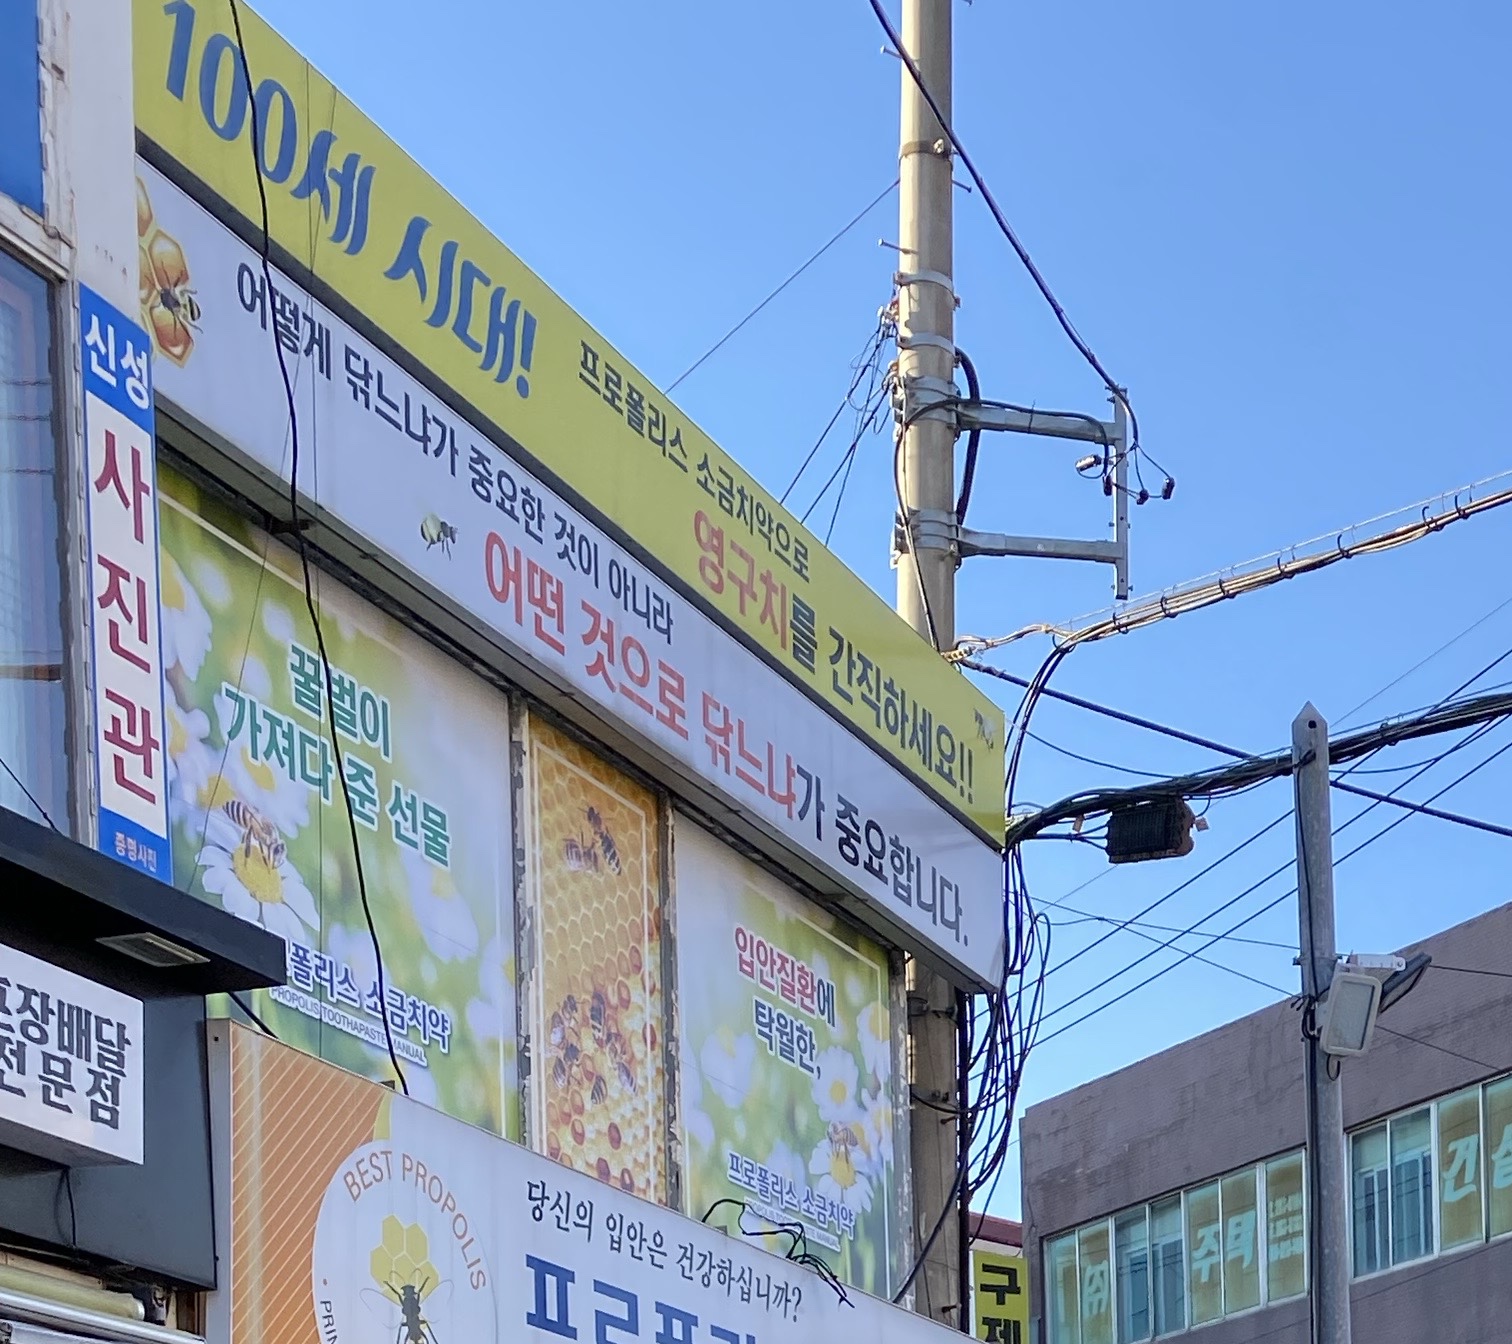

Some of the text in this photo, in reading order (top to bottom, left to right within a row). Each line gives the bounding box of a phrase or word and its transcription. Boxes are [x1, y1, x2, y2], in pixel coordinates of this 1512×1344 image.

[164, 0, 537, 399] 100세 시대!
[85, 314, 151, 410] 신성
[237, 262, 673, 644] 어떻게 닦느냐가 중요한 것이 아니라
[578, 340, 810, 583] 프로폴리스 소금치약으로
[94, 428, 160, 804] 사진관
[693, 509, 975, 804] 영구치를 간직하세요!!
[291, 644, 390, 757] 꿀벌이
[484, 529, 970, 945] 어떤 것으로 닦느냐가 중요합니다.
[223, 687, 450, 866] 가져다 준 선물
[113, 830, 158, 873] 증명사진
[271, 987, 319, 1015] PROPOLIS
[288, 942, 449, 1052] 폴리스 소금치약
[734, 926, 836, 1028] 입안질환에
[754, 998, 824, 1079] 탁월한,
[343, 1150, 487, 1291] BEST PROPOLIS
[526, 1179, 802, 1323] 당신의 입안은 건강하십니까?
[728, 1152, 798, 1208] 프로폴리스
[802, 1189, 854, 1238] 소금치약
